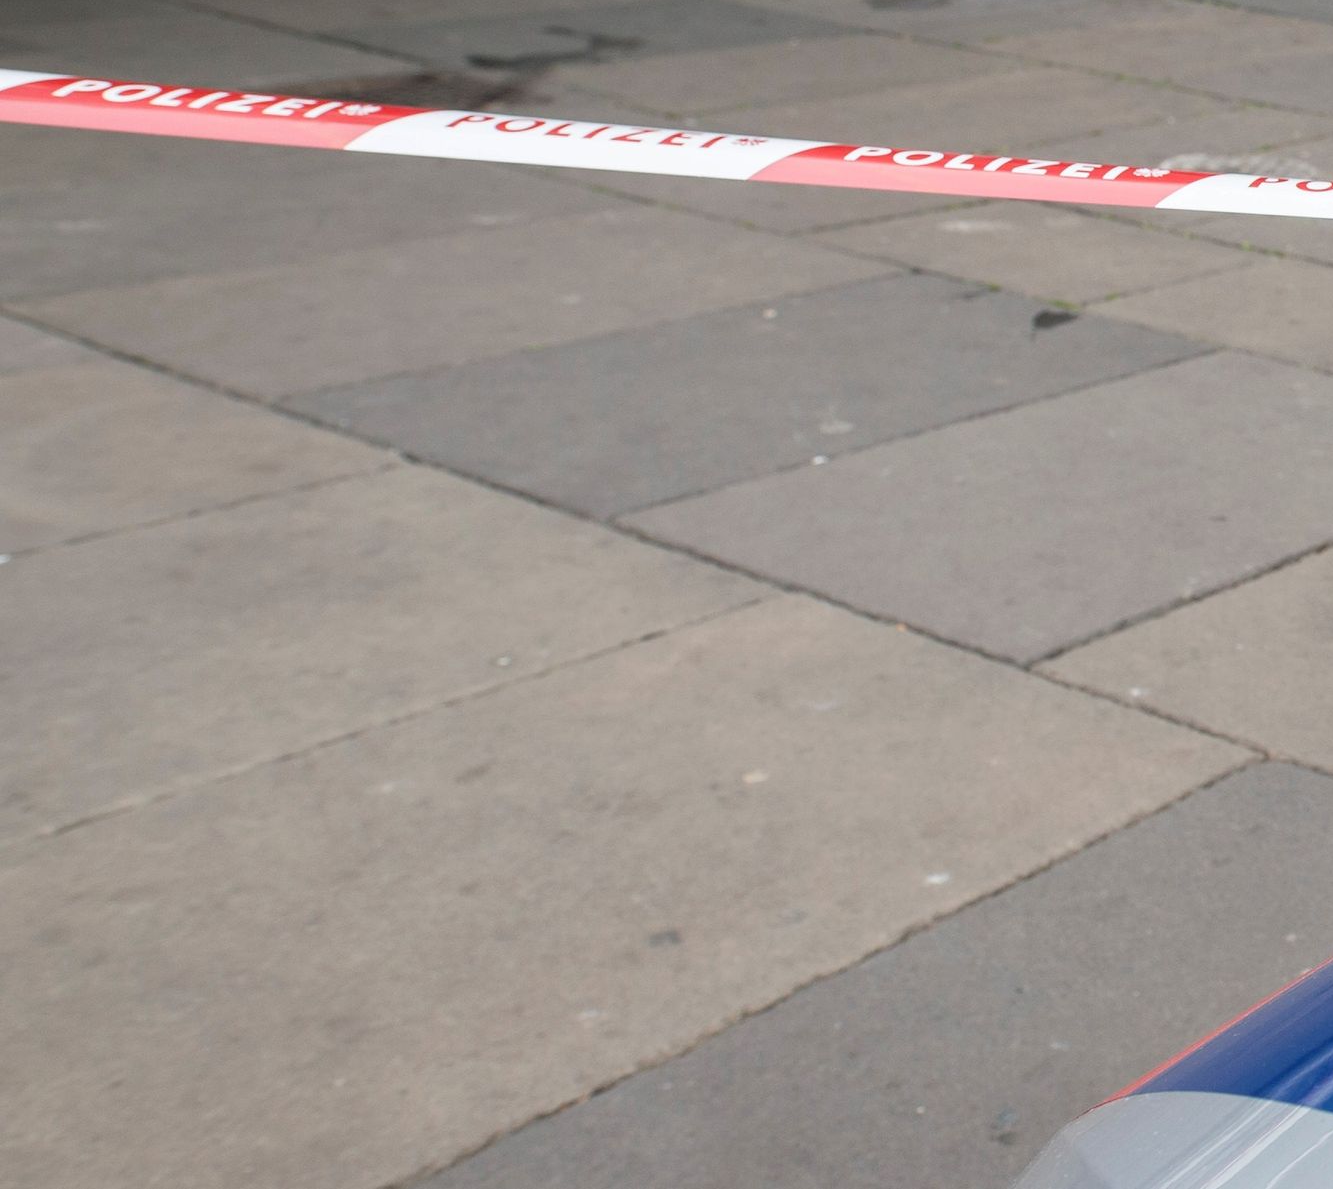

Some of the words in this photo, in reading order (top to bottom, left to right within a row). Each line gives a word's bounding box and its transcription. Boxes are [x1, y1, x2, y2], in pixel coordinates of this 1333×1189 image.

[52, 79, 343, 118] POLIZEI
[446, 114, 725, 148] POLIZEI
[844, 146, 1128, 180] POLIZEI
